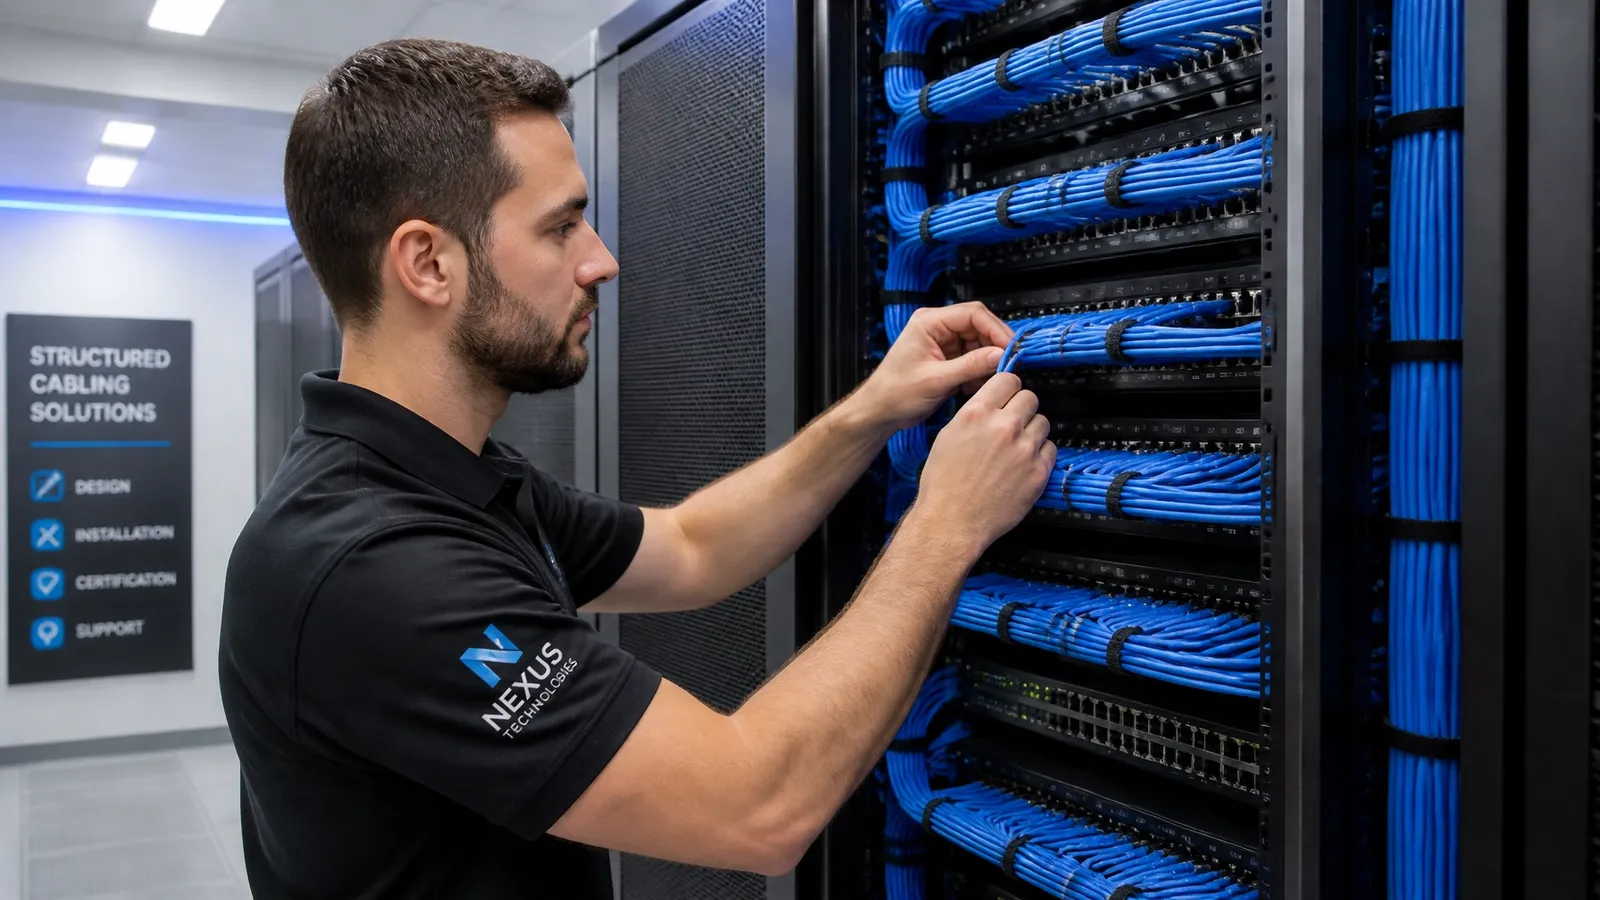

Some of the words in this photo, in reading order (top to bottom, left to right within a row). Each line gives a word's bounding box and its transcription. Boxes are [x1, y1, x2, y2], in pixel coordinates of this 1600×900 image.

[29, 345, 171, 368] STRUCTURED
[29, 373, 131, 395] CABLING
[29, 401, 157, 423] SOLUTIONS
[75, 479, 131, 494] DESIGN
[75, 525, 174, 542] INSTALLATION
[75, 572, 177, 590] CERTIFICATION
[75, 620, 145, 638] SUPPORT
[481, 641, 563, 732] NEXUS
